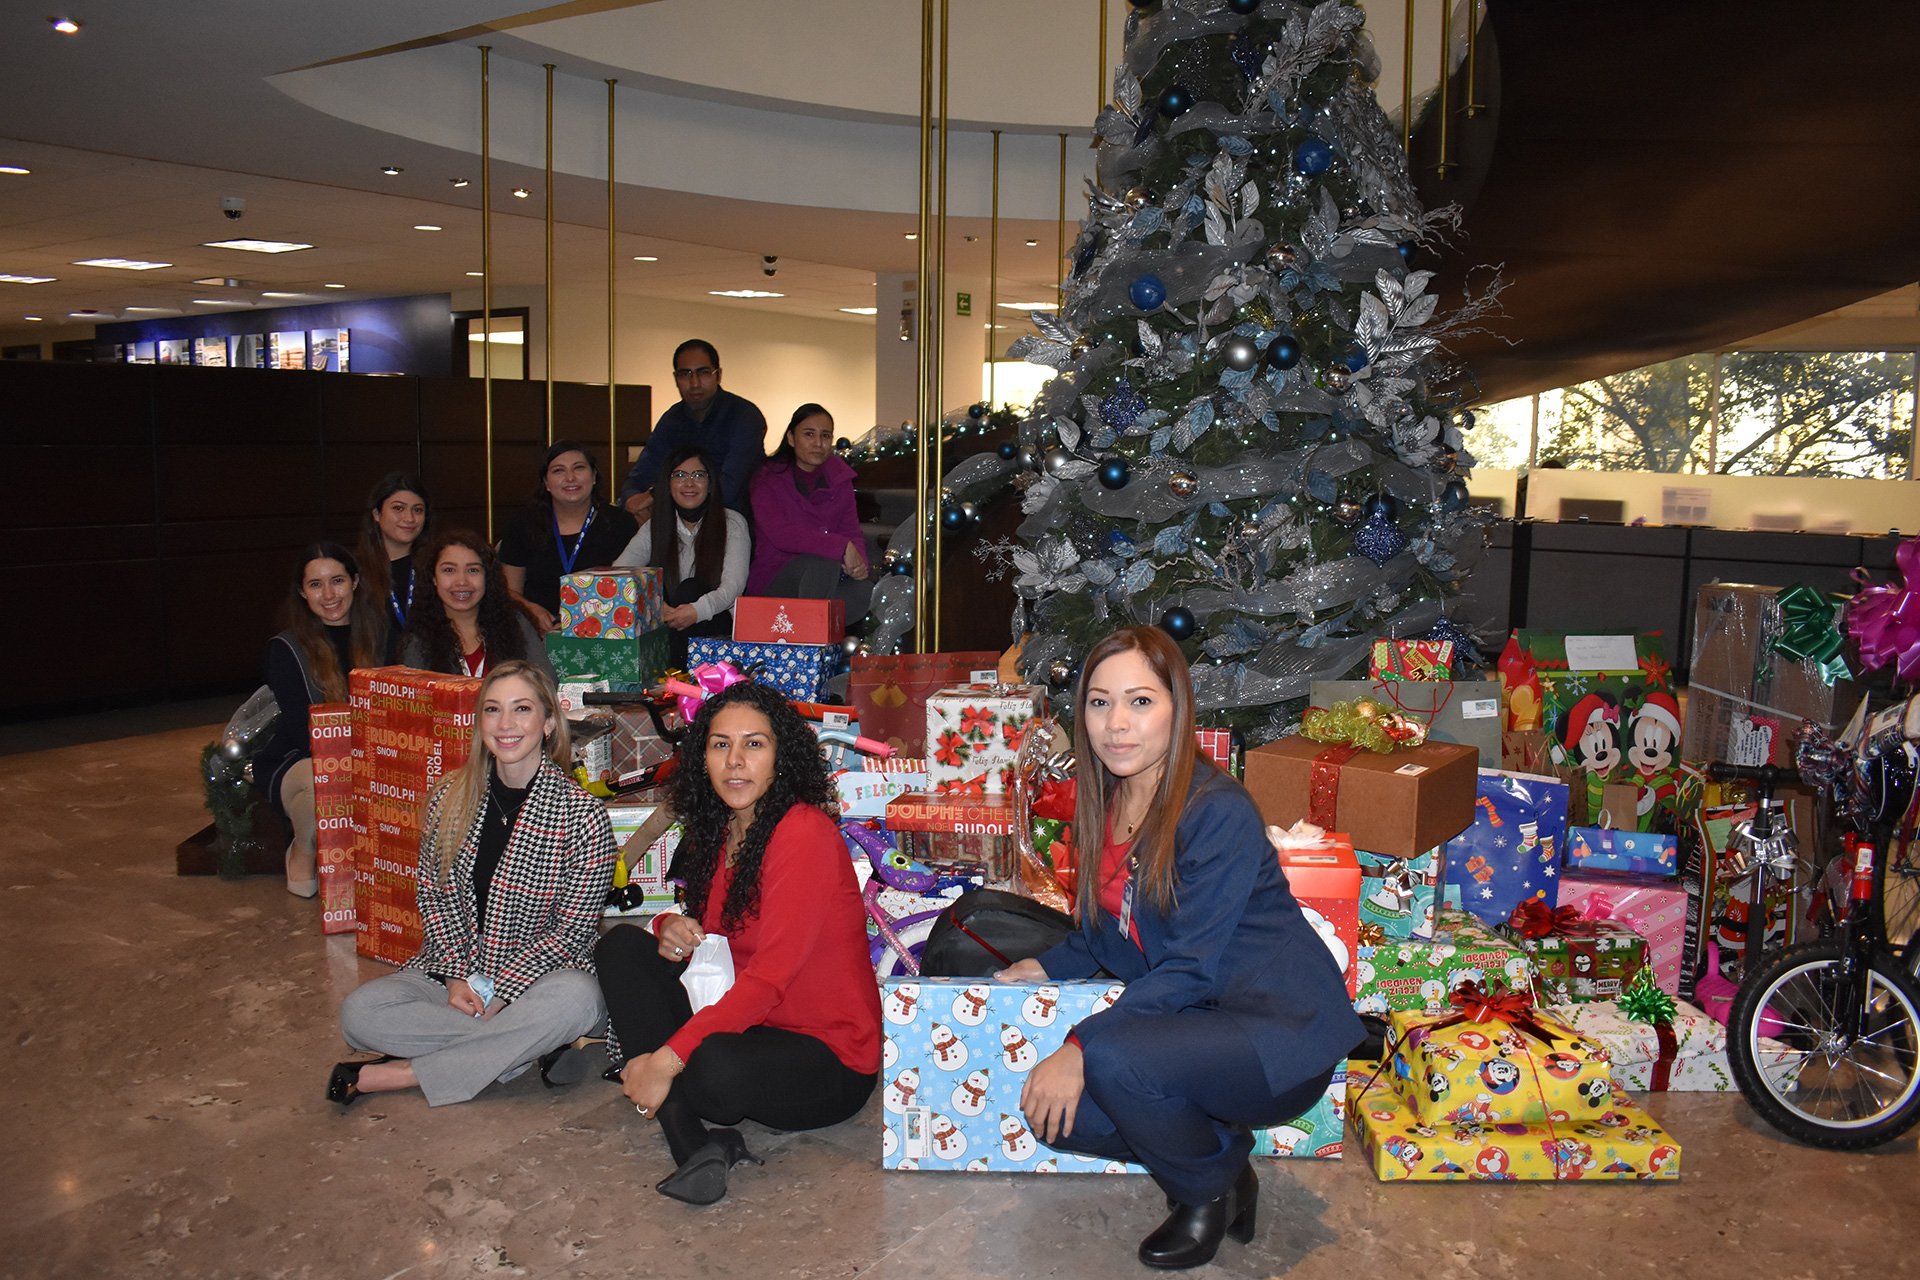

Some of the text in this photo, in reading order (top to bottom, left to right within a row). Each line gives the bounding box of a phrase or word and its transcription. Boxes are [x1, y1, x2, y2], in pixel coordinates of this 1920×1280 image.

[370, 680, 415, 699] RUDOLPH
[371, 694, 434, 717] CHRISTMAS
[311, 725, 352, 739] RUDO
[370, 727, 434, 754] RUDOLPH
[376, 745, 398, 758] SNOW
[433, 739, 442, 775] NOEL
[426, 755, 435, 791] NOEL
[370, 780, 415, 801] RUDOLPH
[886, 803, 955, 820] DOLPH
[380, 822, 401, 835] SNOW
[926, 822, 953, 832] NOEL
[318, 864, 335, 874] SN
[373, 856, 419, 880] RUDOLPH
[323, 908, 357, 923] UDO
[380, 920, 403, 935] SNOW
